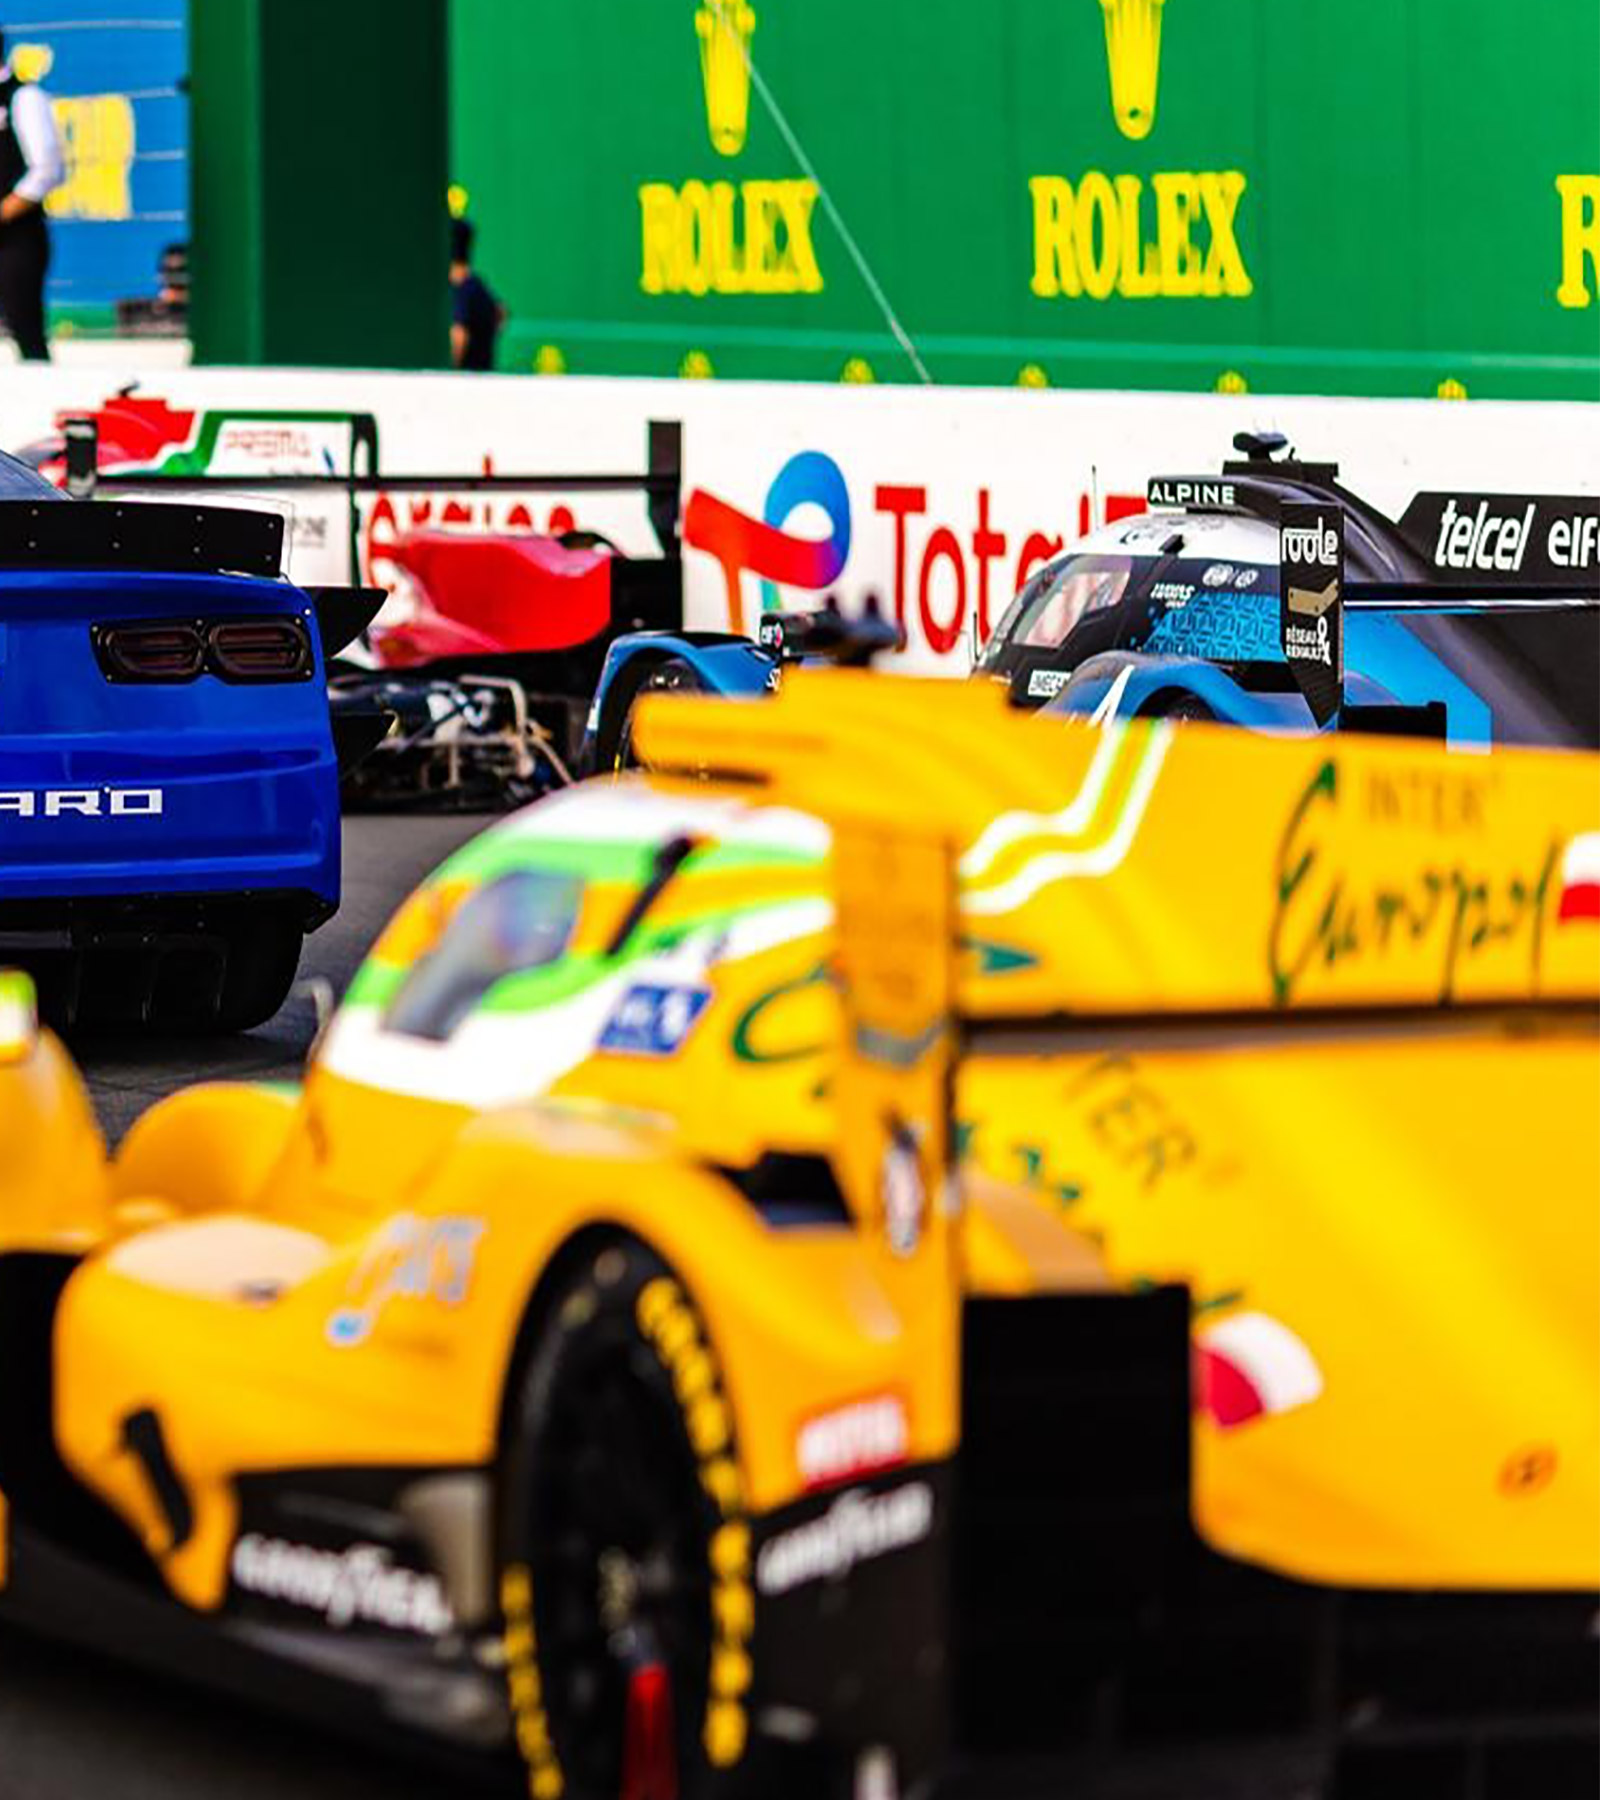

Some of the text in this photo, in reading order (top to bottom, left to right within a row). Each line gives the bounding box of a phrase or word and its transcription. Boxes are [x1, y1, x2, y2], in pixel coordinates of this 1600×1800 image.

[639, 178, 824, 296] ROLEX
[1029, 170, 1253, 300] ROLEX
[1149, 483, 1235, 505] ALPINE
[1435, 499, 1598, 571] telcel elf
